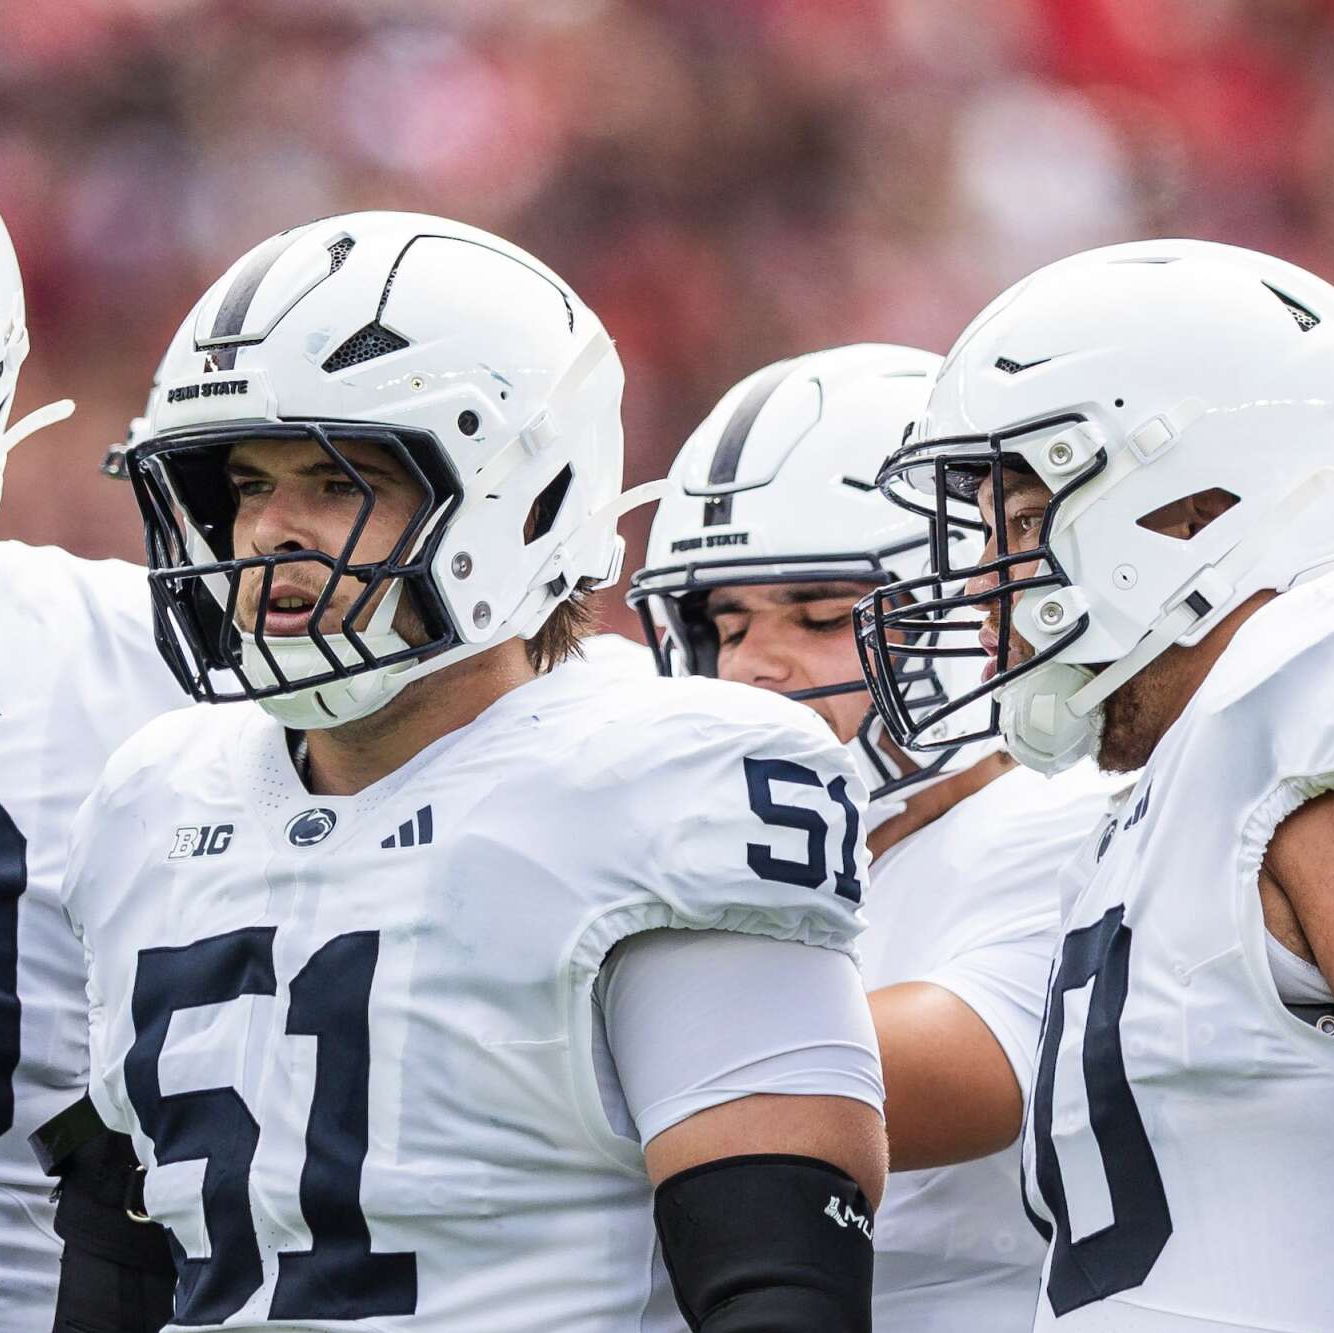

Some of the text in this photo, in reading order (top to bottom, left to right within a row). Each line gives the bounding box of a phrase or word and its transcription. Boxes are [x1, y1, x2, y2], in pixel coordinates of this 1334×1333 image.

[167, 380, 249, 404] PENN STATE
[743, 756, 862, 904] 51
[125, 926, 417, 1326] 51
[1020, 902, 1174, 1319] 0
